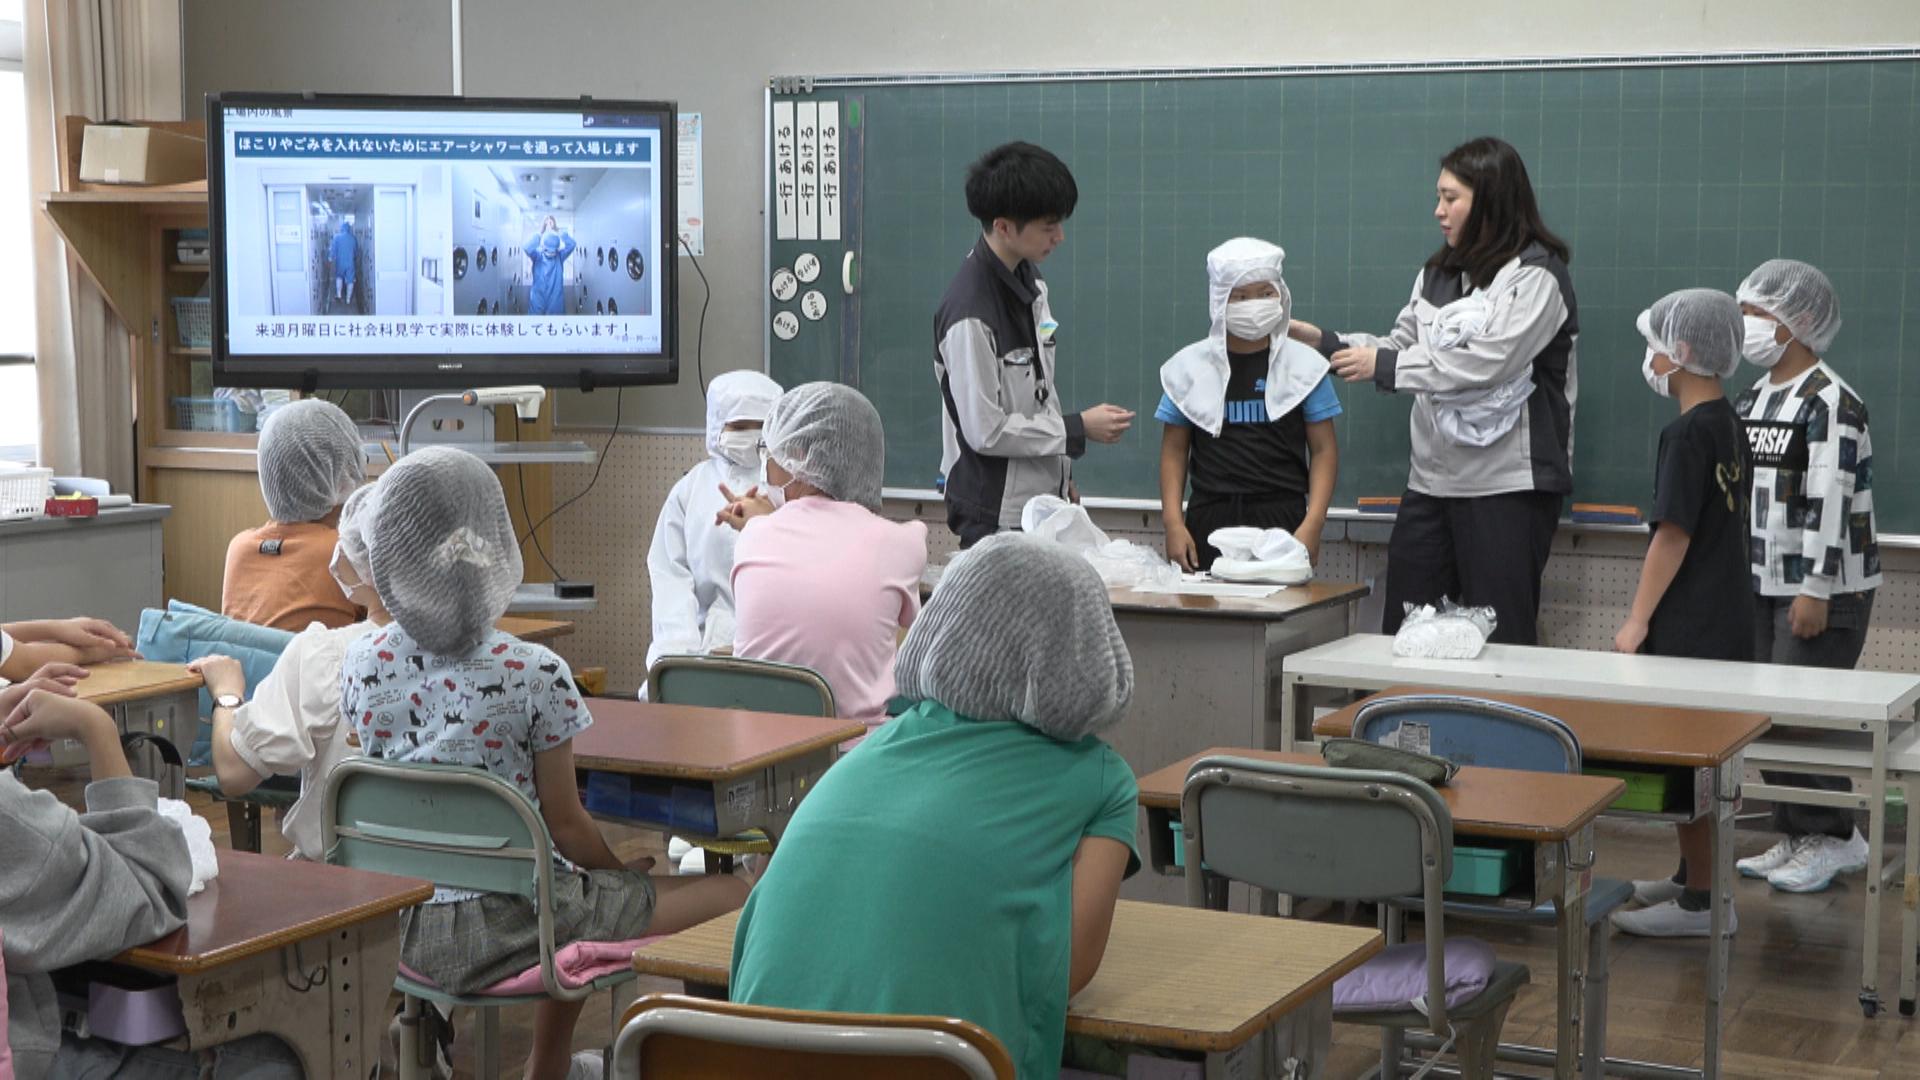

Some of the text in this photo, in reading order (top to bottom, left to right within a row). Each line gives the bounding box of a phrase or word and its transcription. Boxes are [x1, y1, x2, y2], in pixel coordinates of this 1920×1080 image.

[238, 136, 640, 156] ほこりやごみを入れないためにエアーシャワーを通って入場します
[1746, 427, 1793, 455] ERSH
